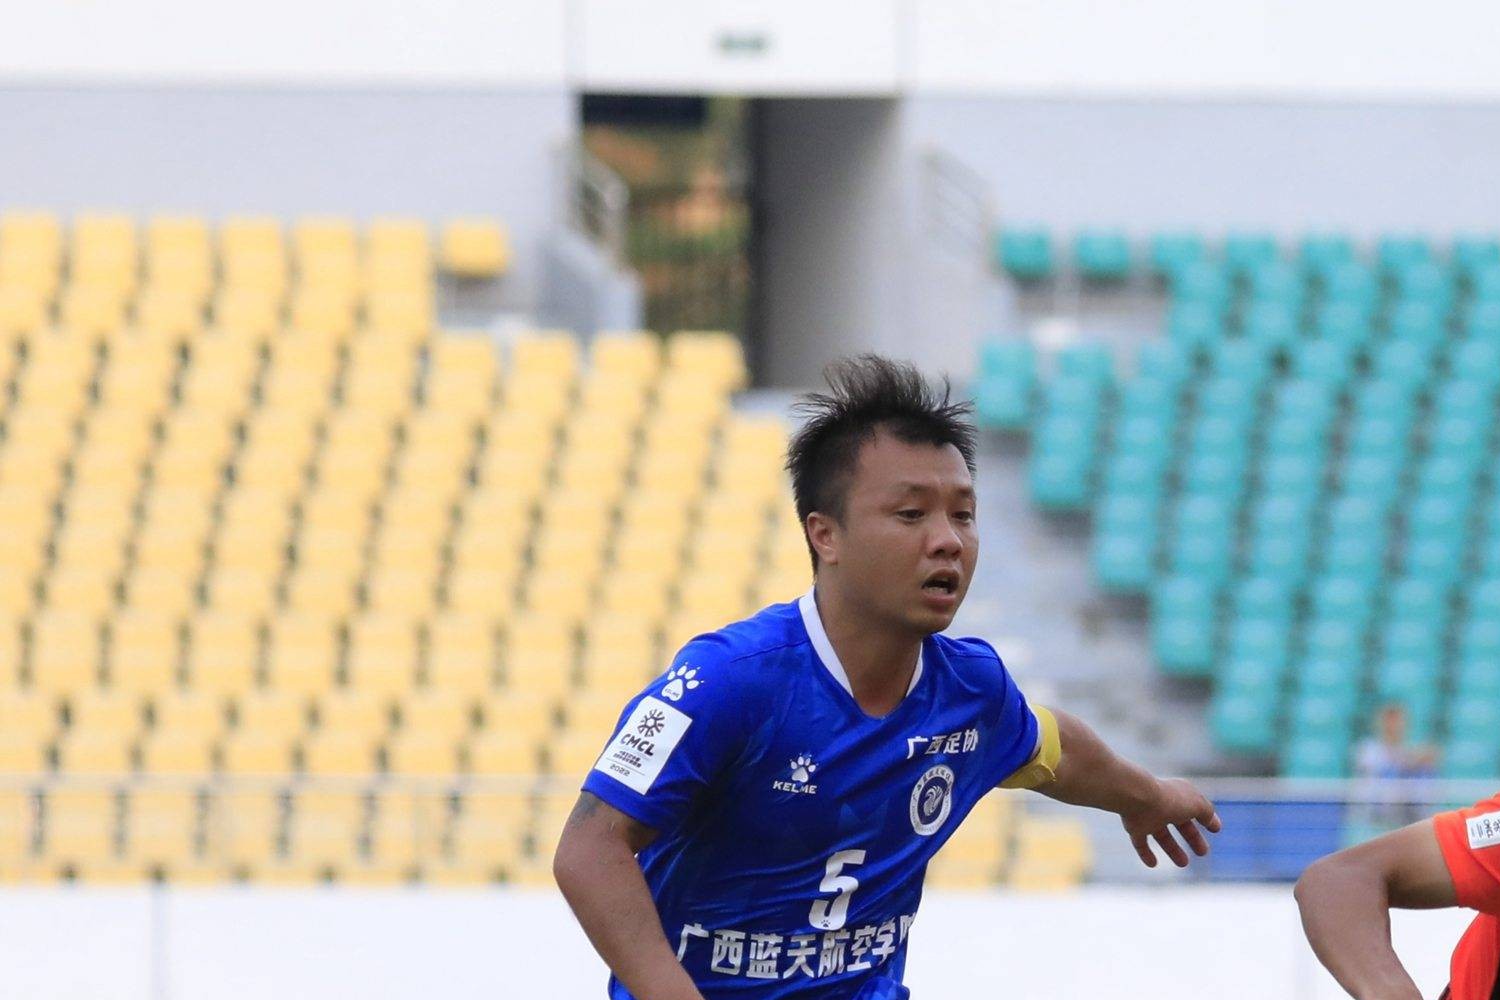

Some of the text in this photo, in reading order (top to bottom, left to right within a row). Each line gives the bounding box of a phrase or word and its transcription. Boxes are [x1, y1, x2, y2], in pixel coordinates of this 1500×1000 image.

[621, 733, 655, 757] CMCL
[906, 728, 979, 760] 广西足协
[609, 763, 631, 777] 2022
[772, 780, 818, 795] KELME
[808, 849, 867, 931] 5
